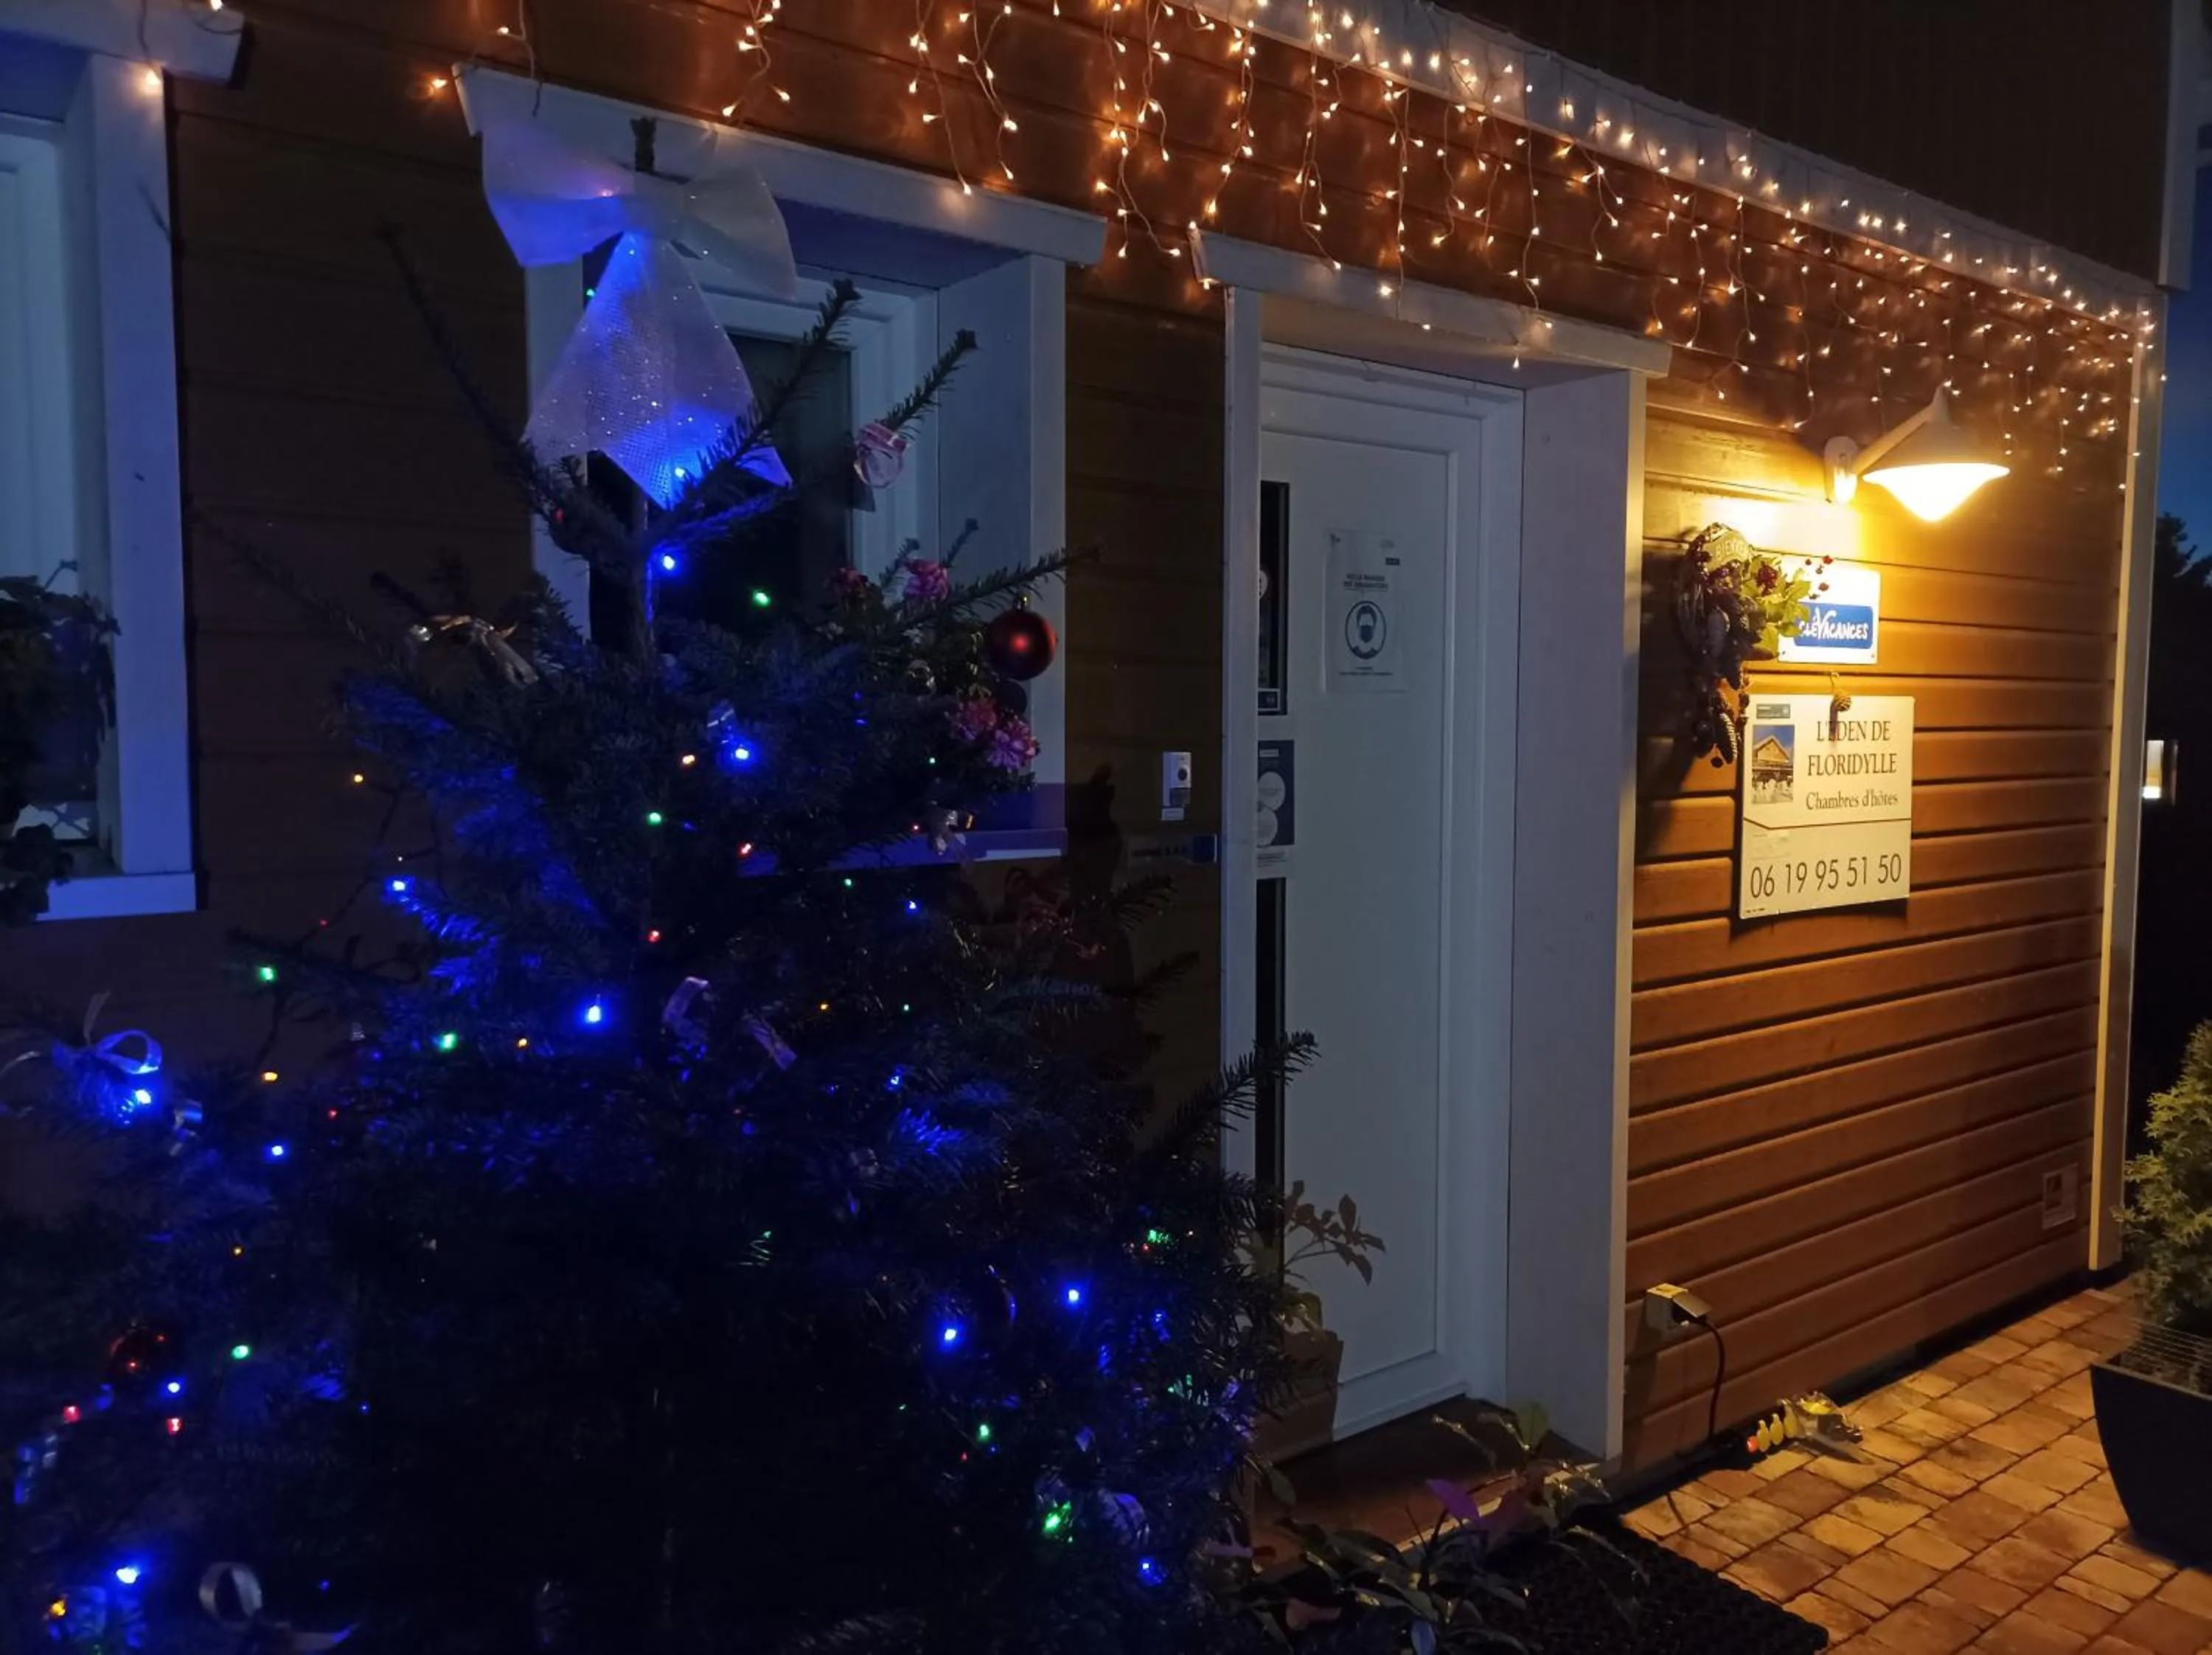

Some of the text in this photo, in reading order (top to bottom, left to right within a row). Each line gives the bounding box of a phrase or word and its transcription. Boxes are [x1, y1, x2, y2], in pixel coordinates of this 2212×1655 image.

[1871, 720, 1892, 741] DE
[1807, 752, 1898, 777] FLORIDYLLE
[1805, 791, 1860, 811] Chambres
[1750, 853, 1902, 899] 06 19 95 51 50
